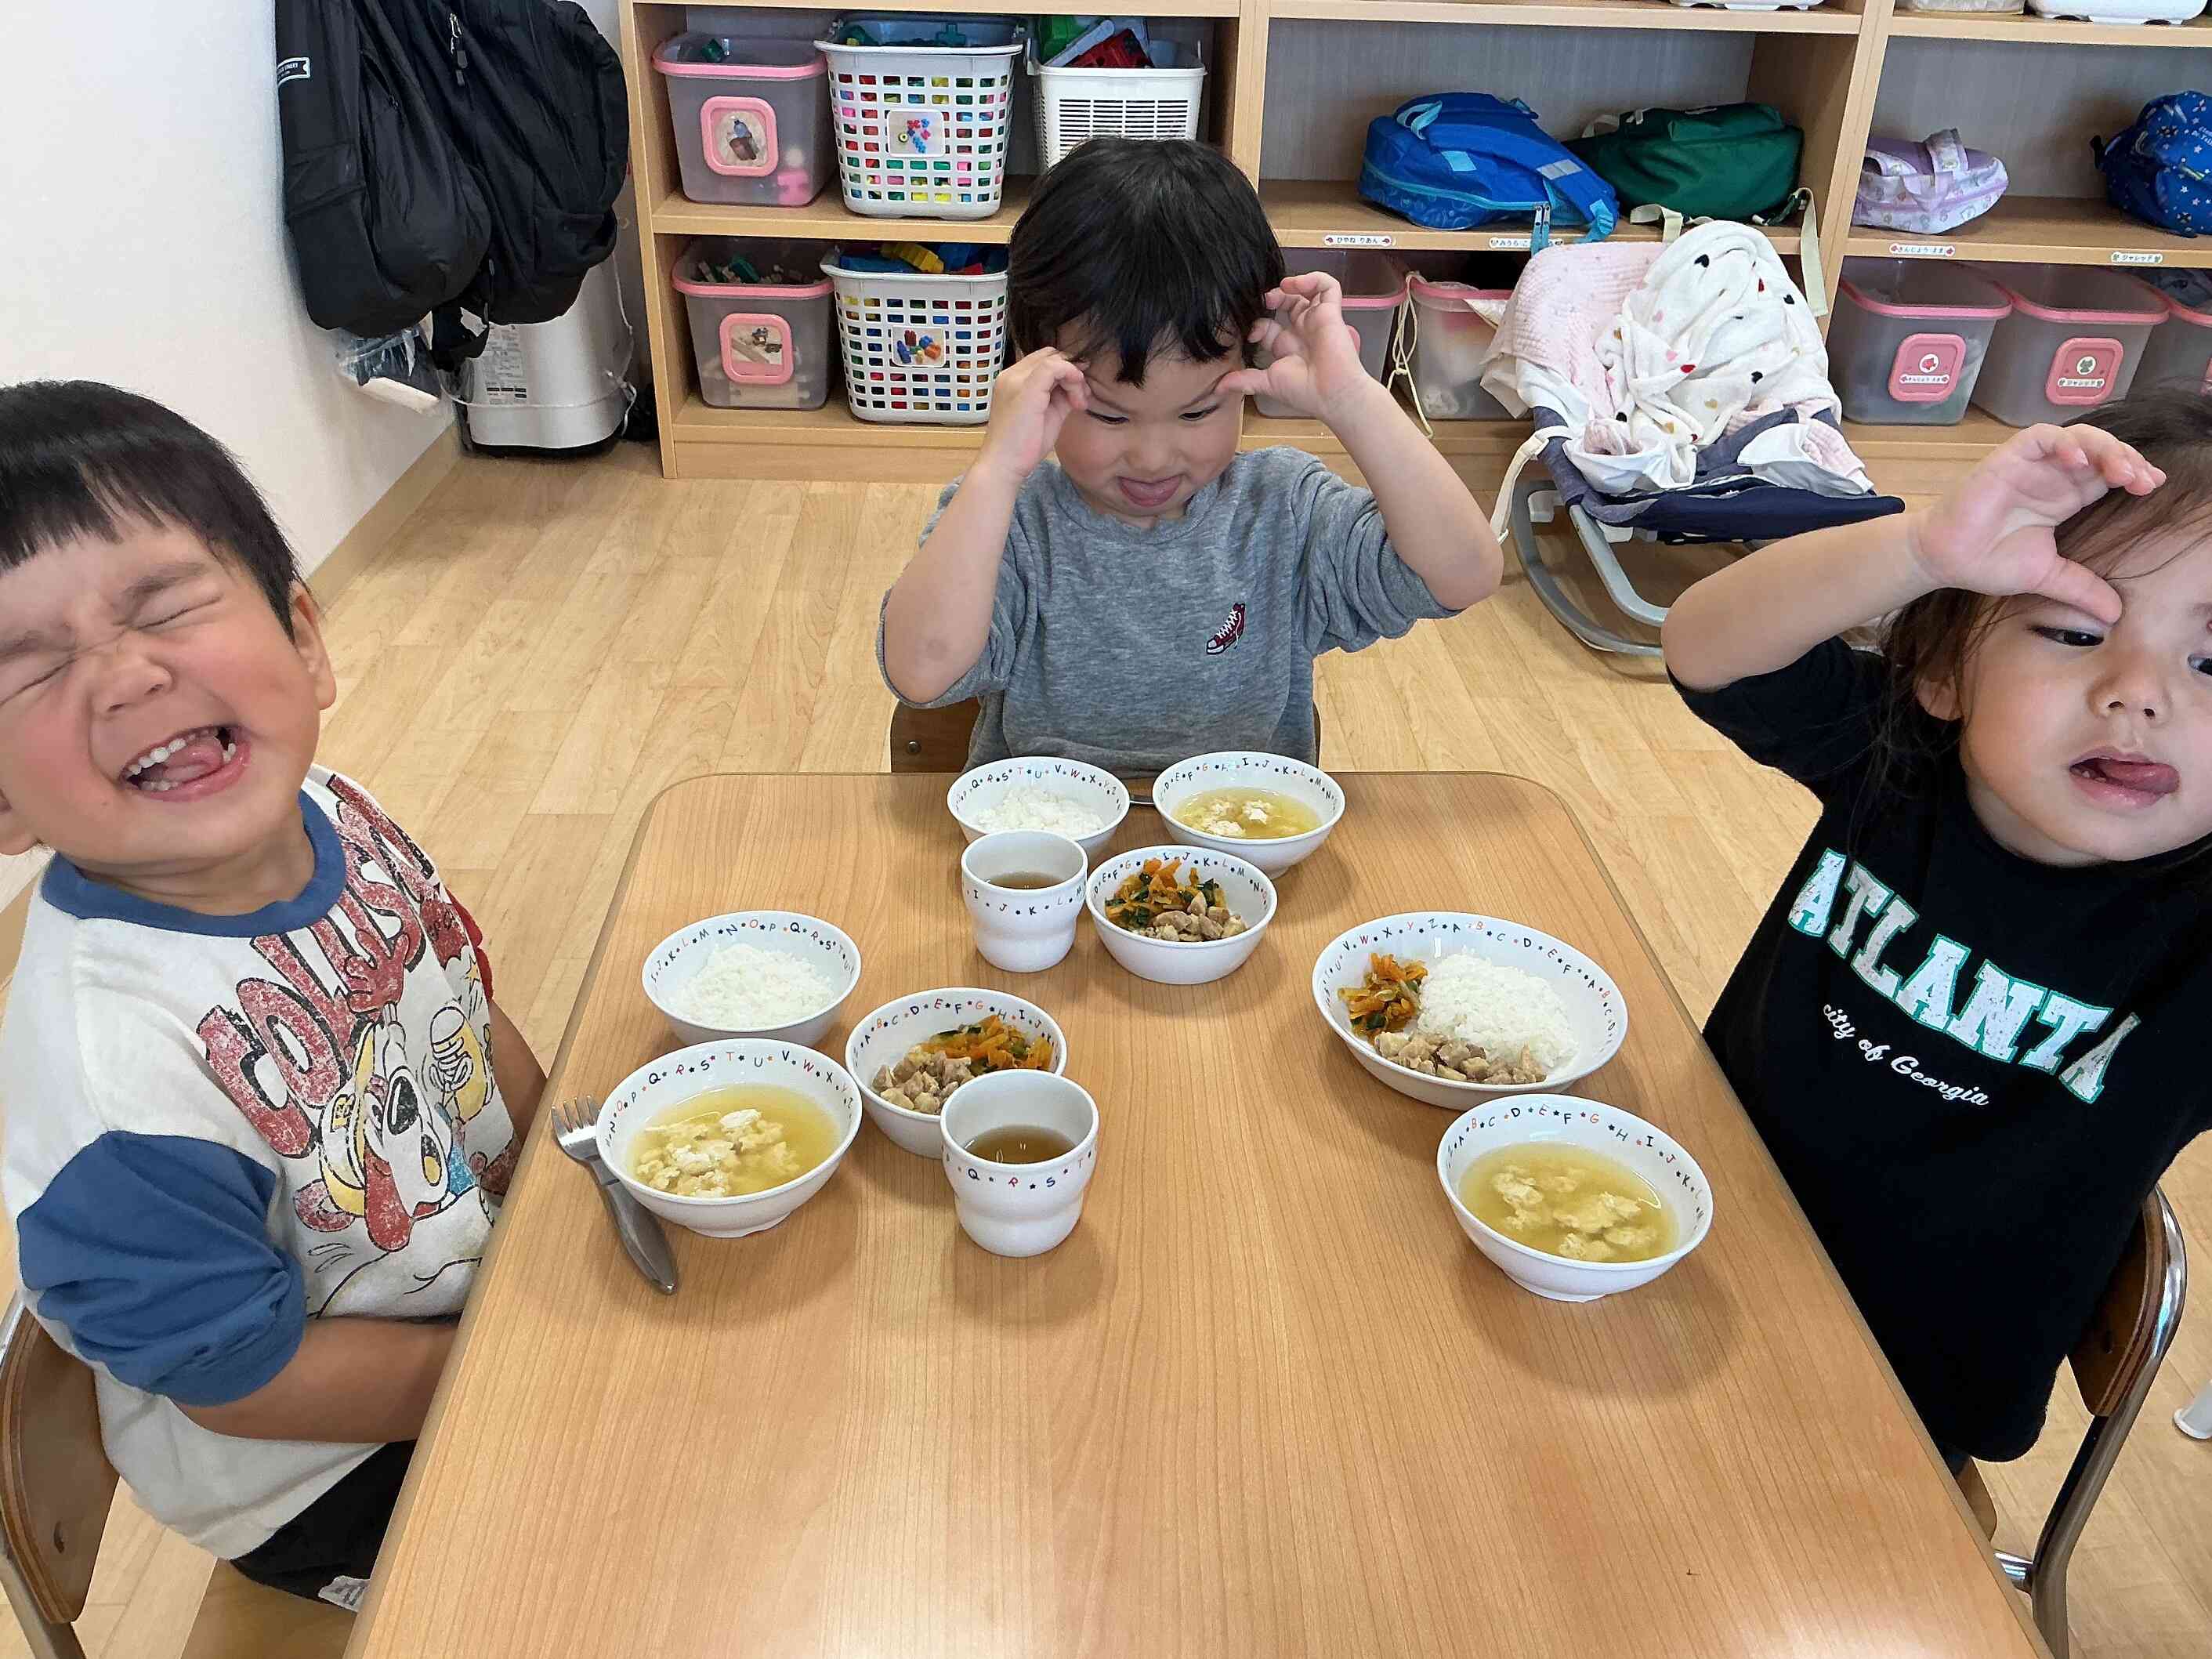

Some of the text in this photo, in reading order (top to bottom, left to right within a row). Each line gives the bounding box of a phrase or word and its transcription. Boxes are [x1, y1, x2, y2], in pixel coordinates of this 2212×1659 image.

[1822, 1004, 1989, 1107] city of Georgia
